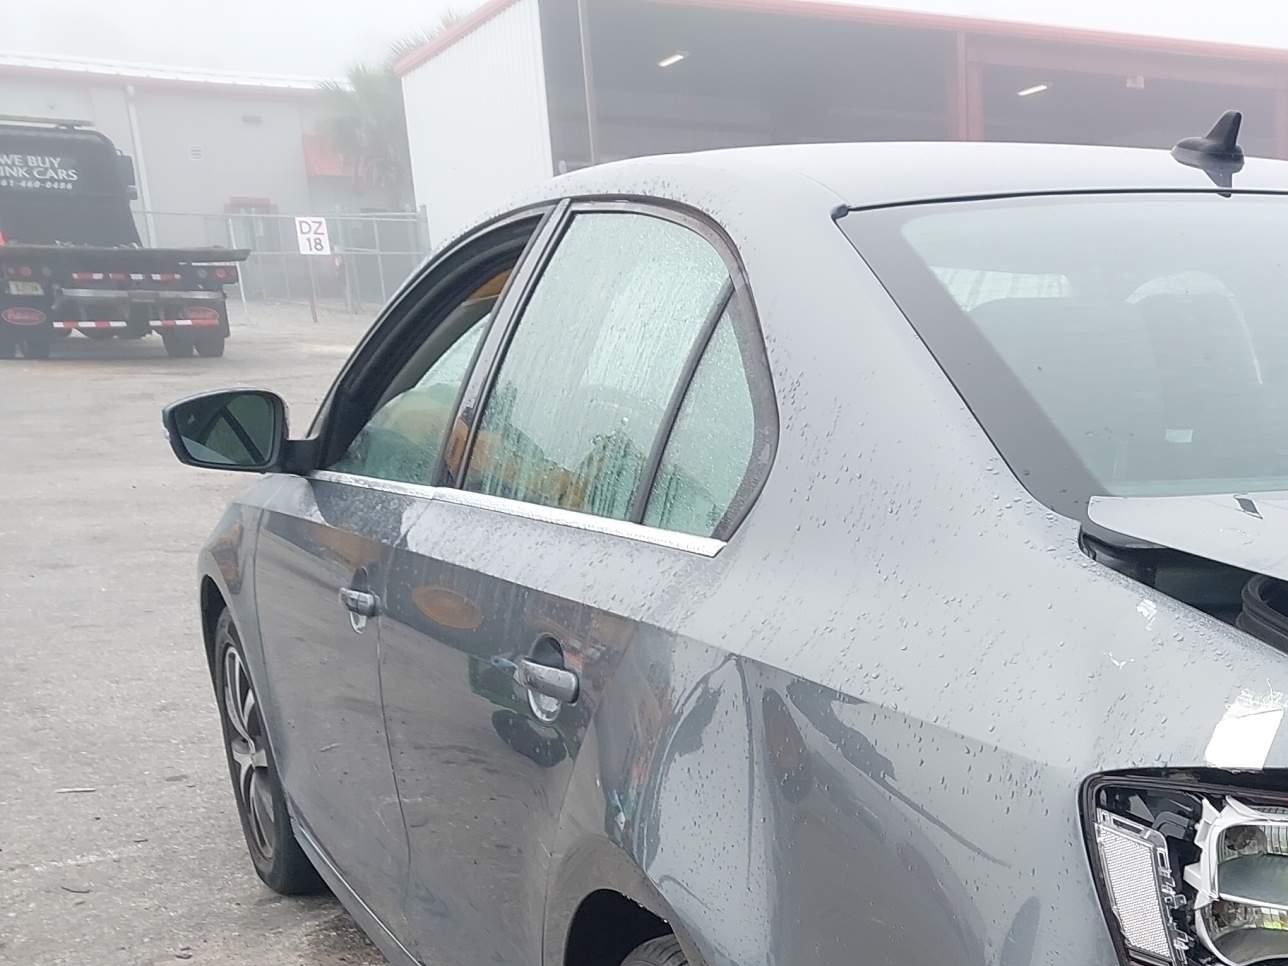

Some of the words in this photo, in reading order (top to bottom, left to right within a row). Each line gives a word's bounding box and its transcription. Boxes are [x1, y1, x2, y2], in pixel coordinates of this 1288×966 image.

[27, 155, 61, 169] BUY
[33, 168, 78, 181] CARS
[299, 220, 325, 235] DZ
[306, 237, 324, 252] 18
